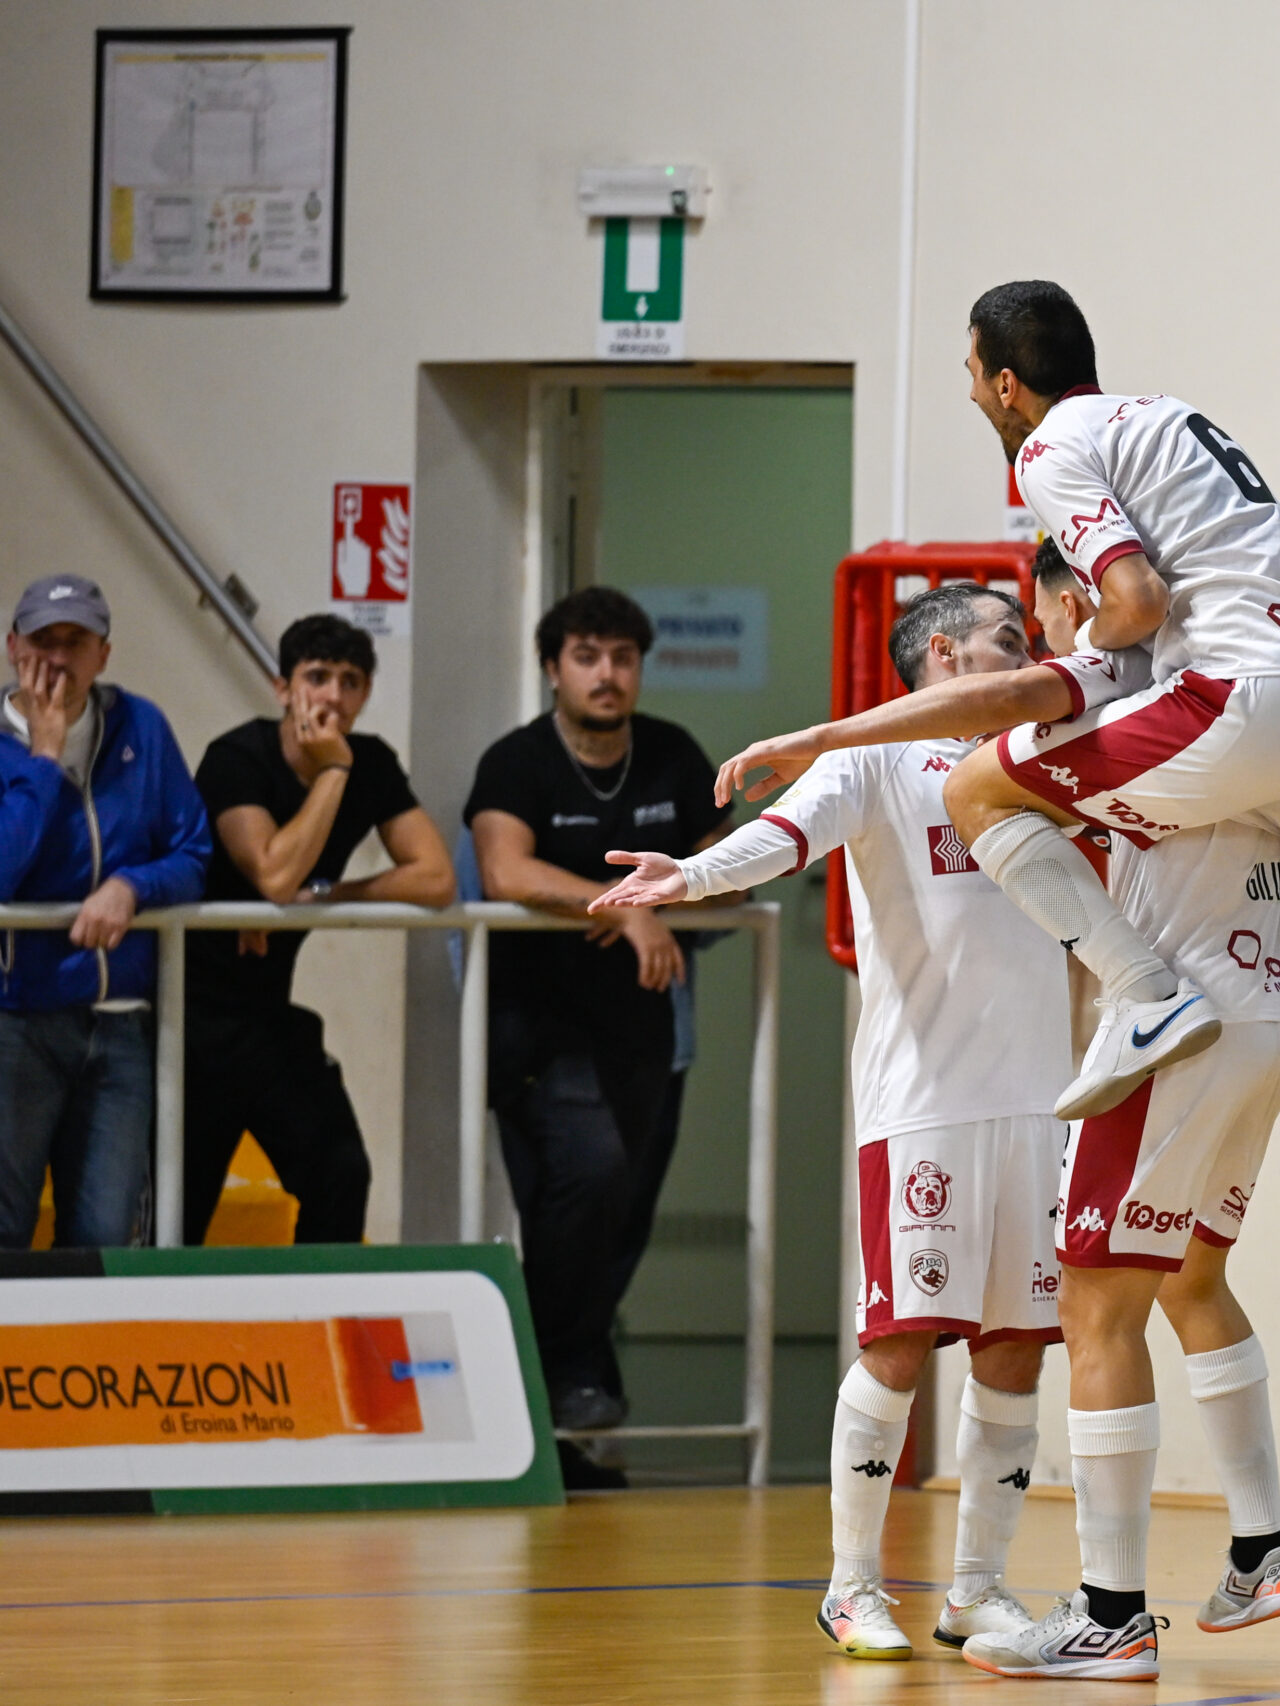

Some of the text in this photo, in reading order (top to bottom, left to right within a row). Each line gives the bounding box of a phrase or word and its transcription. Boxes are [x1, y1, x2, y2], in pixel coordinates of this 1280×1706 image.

[1186, 412, 1277, 504] 6
[0, 1361, 291, 1411] ECORAZIONI
[160, 1414, 177, 1434] di
[242, 1412, 296, 1432] Mario
